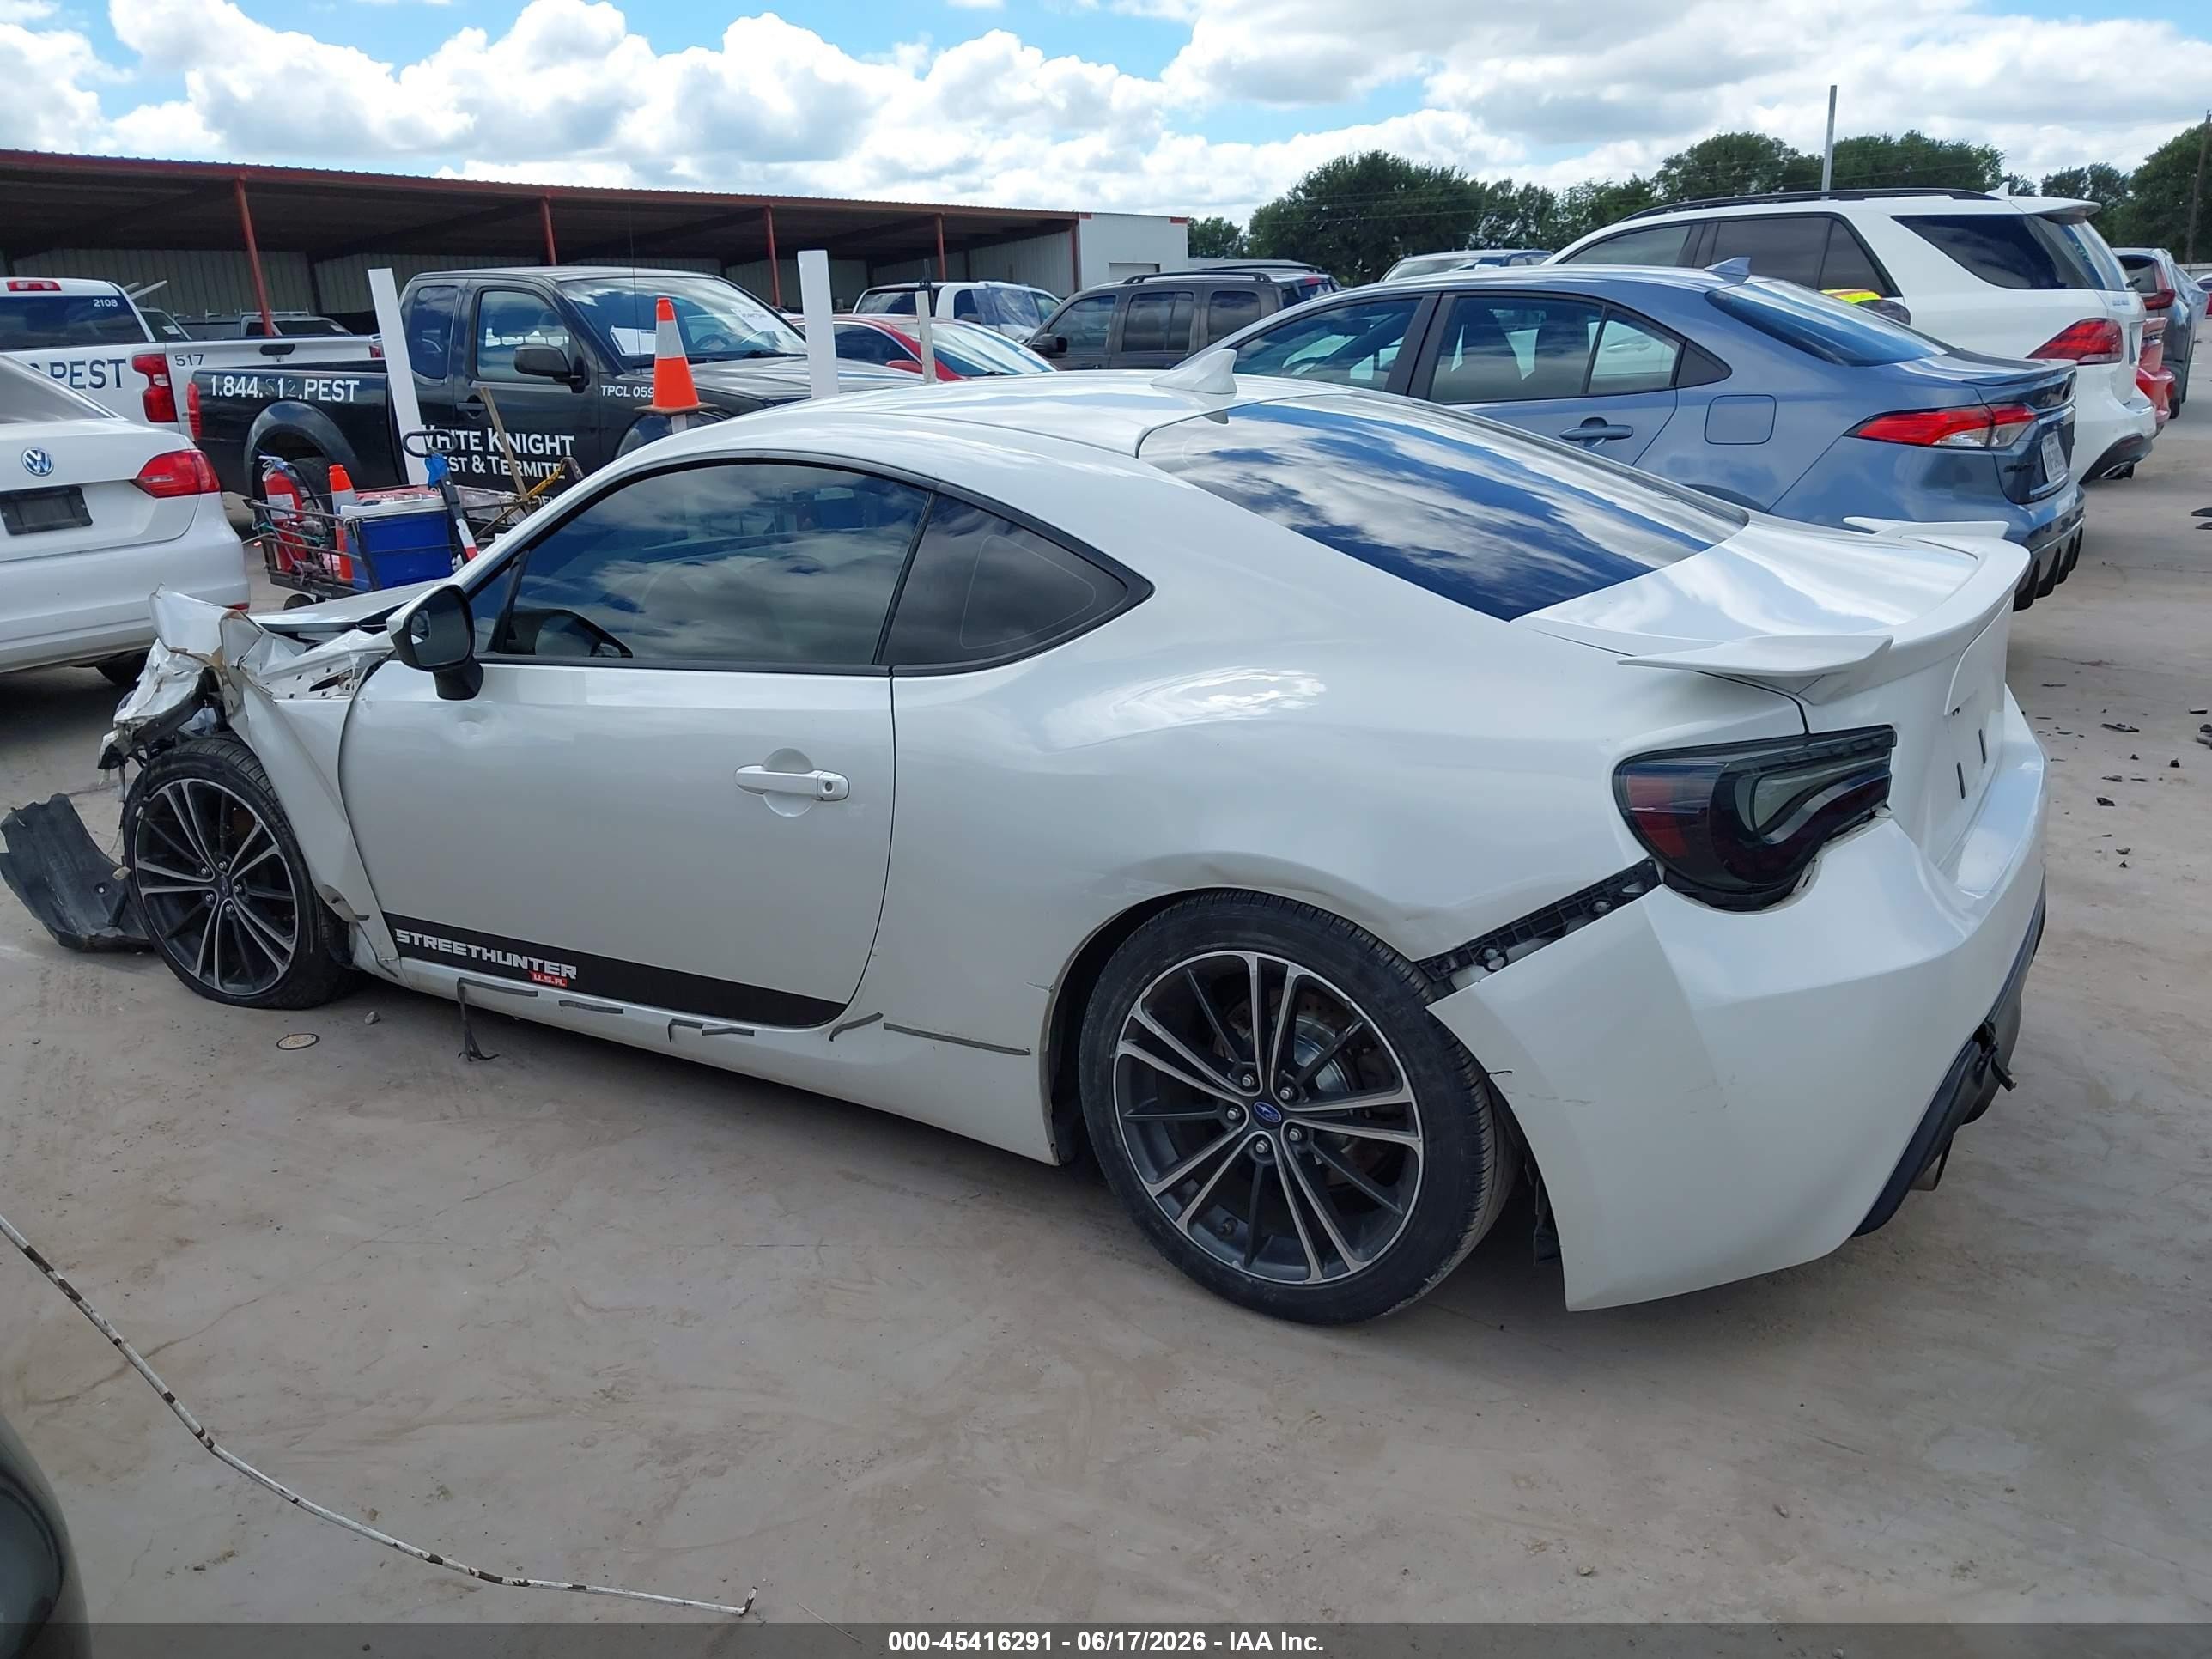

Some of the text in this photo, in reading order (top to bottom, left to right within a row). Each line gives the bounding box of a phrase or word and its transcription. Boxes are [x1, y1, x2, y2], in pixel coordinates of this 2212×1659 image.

[94, 298, 118, 307] 2108
[174, 354, 204, 367] 517
[600, 385, 631, 398] TPCL
[487, 428, 575, 456] KNIGHT
[471, 454, 487, 474] &
[395, 928, 577, 980] STREETHUNTER
